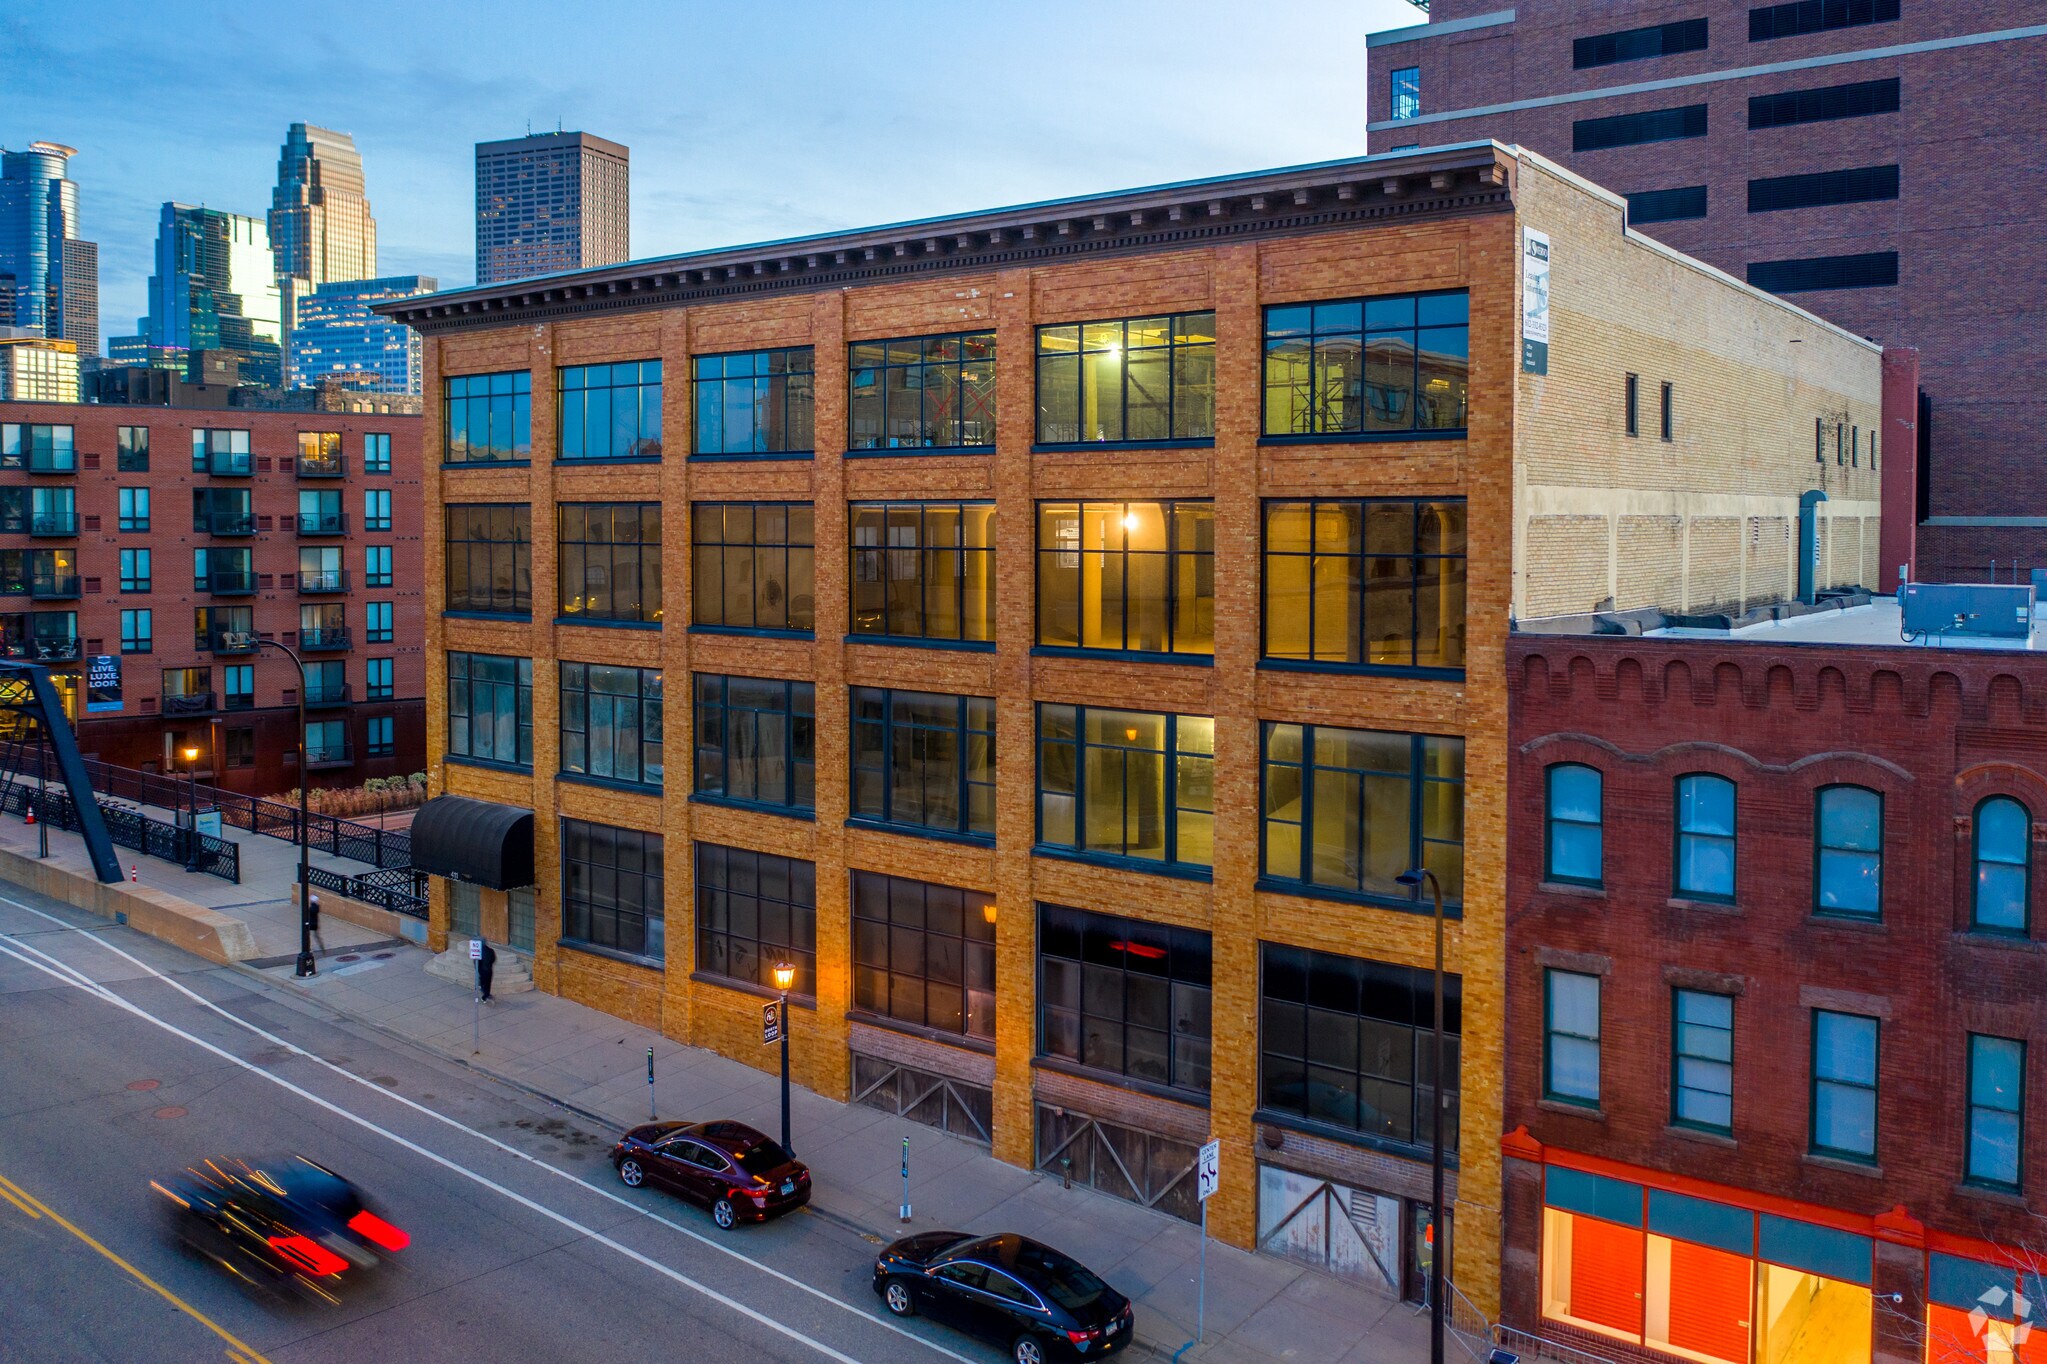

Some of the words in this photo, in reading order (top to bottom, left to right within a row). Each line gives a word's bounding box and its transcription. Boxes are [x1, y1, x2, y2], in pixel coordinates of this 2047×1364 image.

[1525, 270, 1540, 284] Leasing
[1525, 281, 1547, 297] Information
[764, 1030, 778, 1038] LOOP
[1201, 1143, 1217, 1155] CENTER
[1203, 1152, 1214, 1161] LANE
[1202, 1186, 1213, 1196] ONLY
